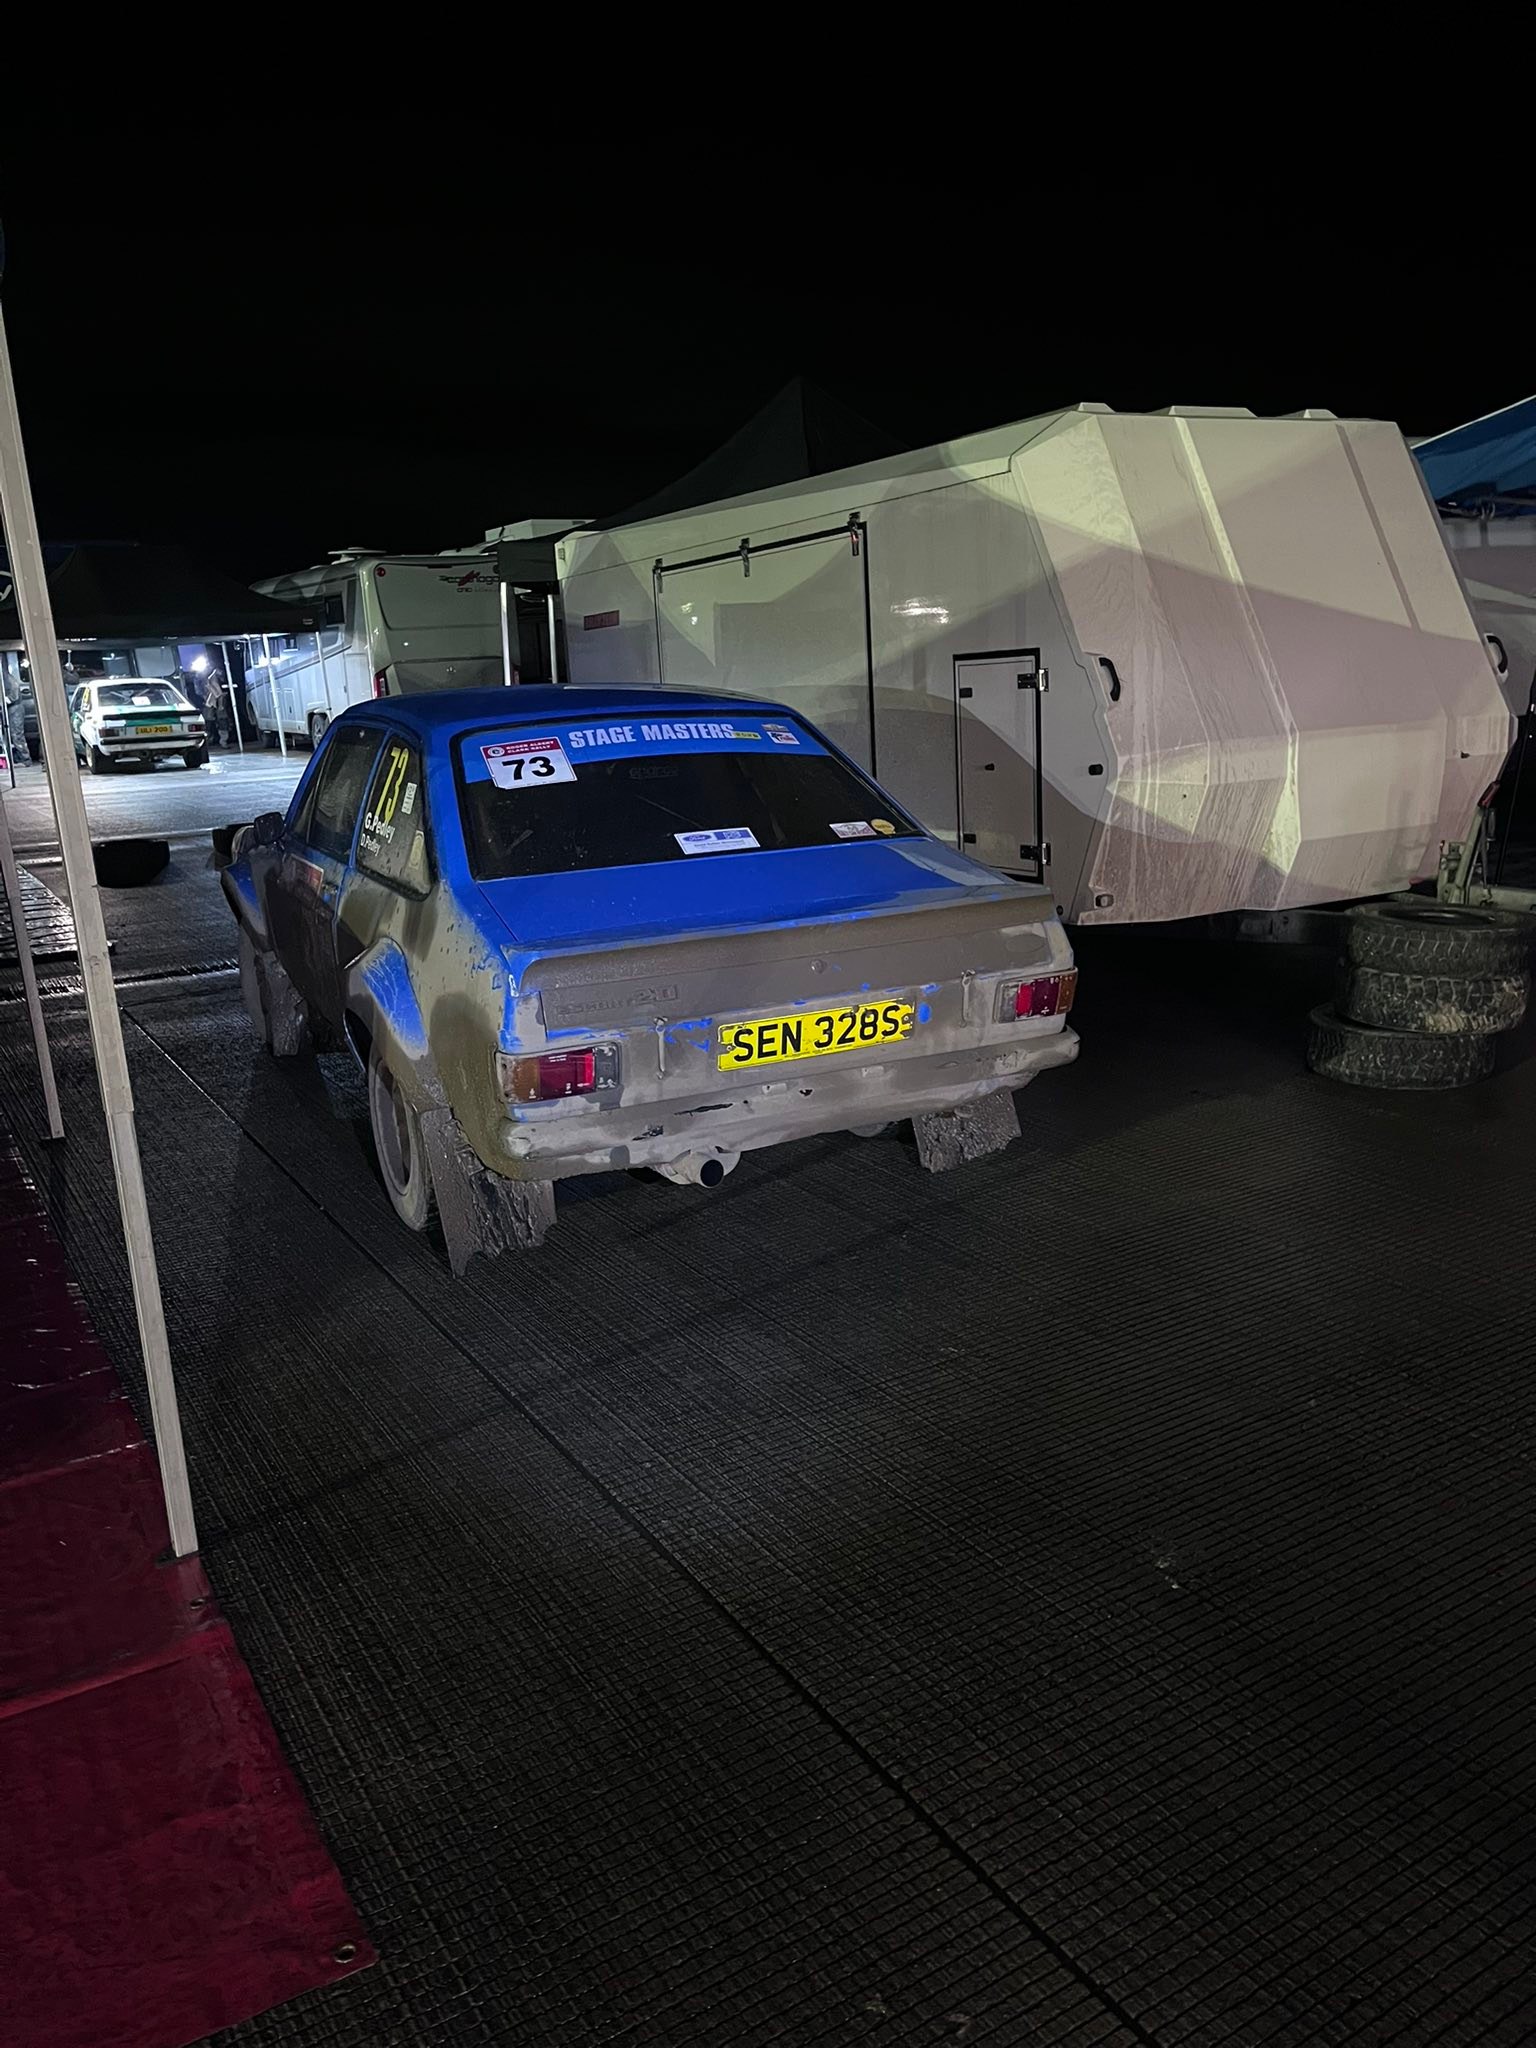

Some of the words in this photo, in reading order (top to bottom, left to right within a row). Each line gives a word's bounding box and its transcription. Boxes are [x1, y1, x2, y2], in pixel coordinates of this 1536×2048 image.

[568, 725, 637, 749] STAGE
[641, 723, 736, 741] MASTERS
[374, 746, 410, 824] 73
[502, 756, 555, 780] 73
[733, 1020, 802, 1062] SEN
[814, 1005, 901, 1049] 328S
